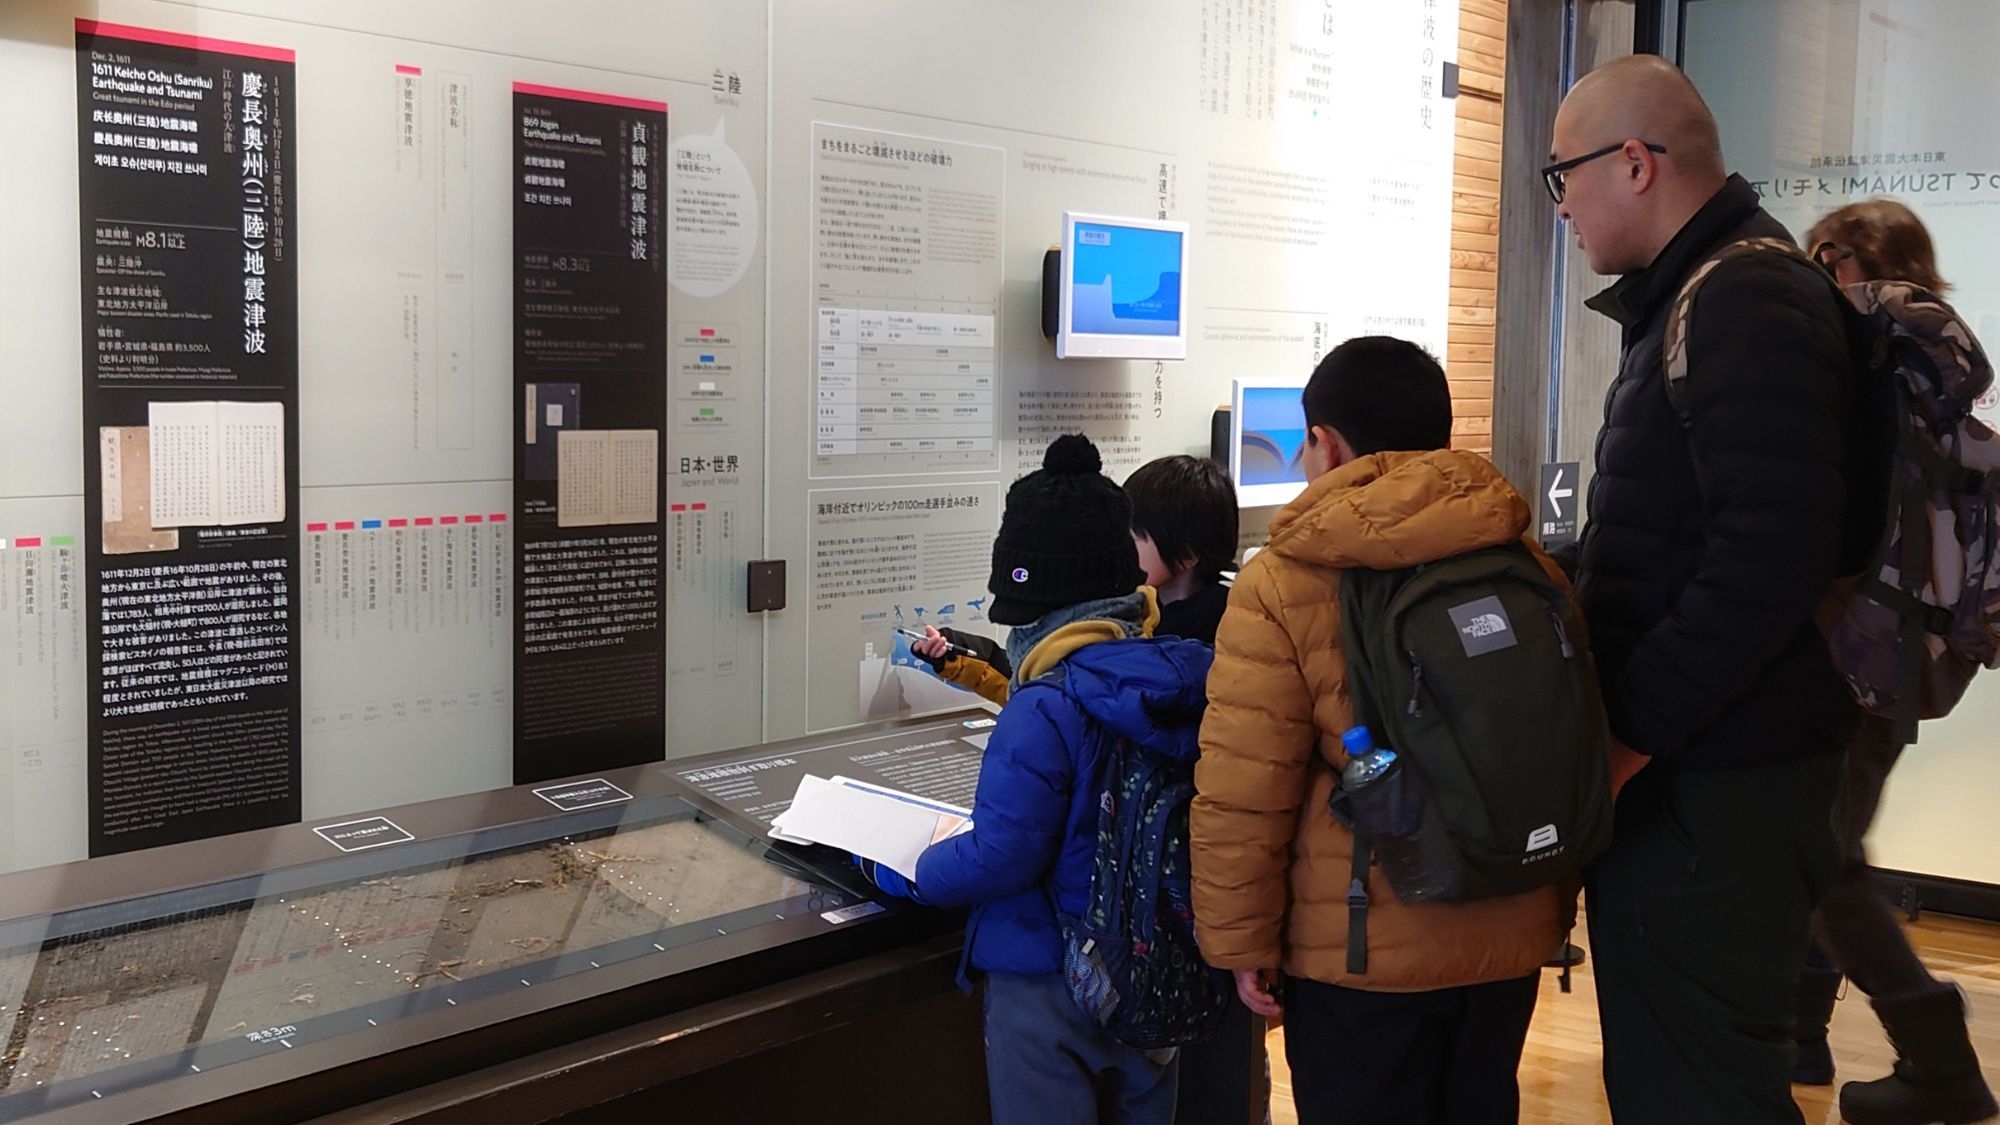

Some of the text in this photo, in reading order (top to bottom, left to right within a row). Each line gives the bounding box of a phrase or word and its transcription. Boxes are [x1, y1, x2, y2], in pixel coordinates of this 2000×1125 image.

[92, 63, 213, 90] 1611 Keicho Oshu (Sanriku)
[712, 73, 742, 95] 三陸
[92, 79, 203, 100] Earthquake and Tsunami
[523, 116, 560, 131] 869 Jogan
[523, 128, 602, 146] Earthquake and Tsunami
